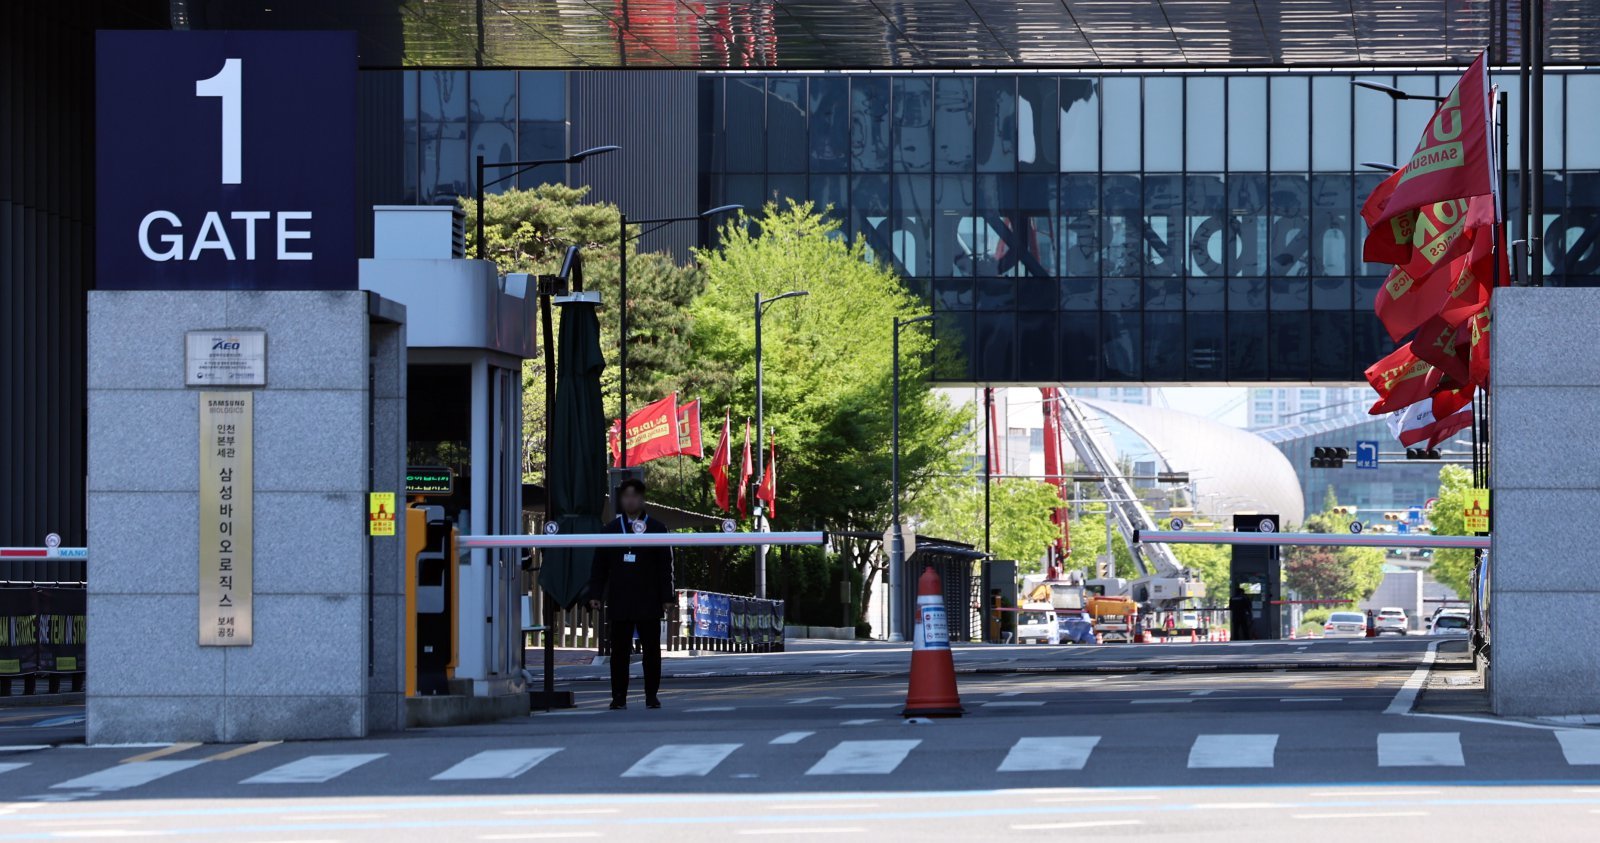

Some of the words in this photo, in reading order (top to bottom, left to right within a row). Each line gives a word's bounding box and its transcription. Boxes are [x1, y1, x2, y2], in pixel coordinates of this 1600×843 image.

[195, 57, 242, 185] 1
[137, 209, 313, 262] GATE
[212, 341, 240, 350] AEO
[208, 399, 245, 407] SAMSUNG
[209, 406, 244, 414] BIOLOGICS
[217, 424, 236, 435] 인천
[217, 436, 236, 447] 본부
[216, 448, 236, 458] 세관
[218, 467, 233, 607] 삼성바이오로직스
[218, 616, 235, 626] 보세
[218, 627, 235, 637] 공장
